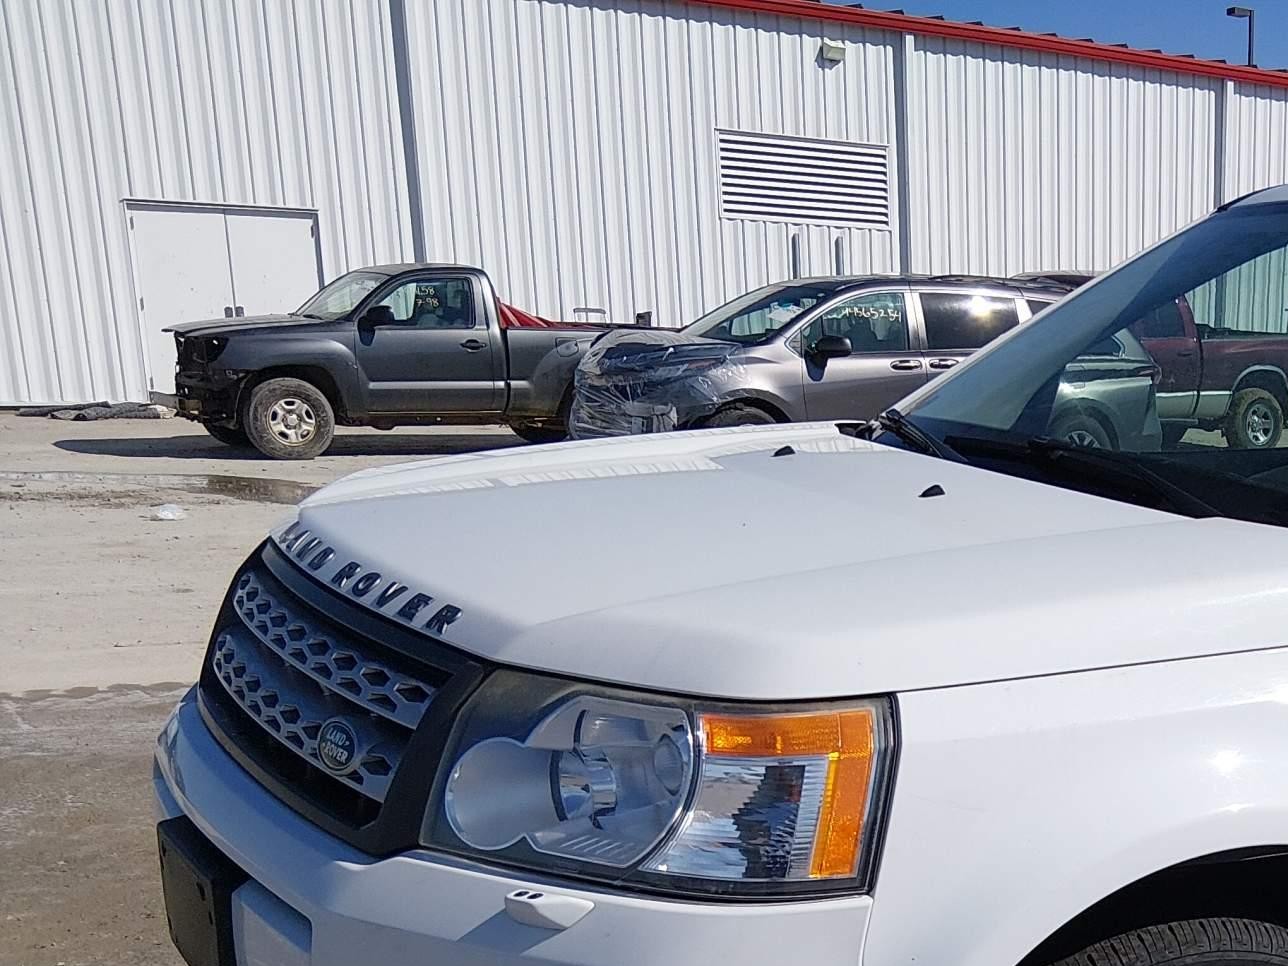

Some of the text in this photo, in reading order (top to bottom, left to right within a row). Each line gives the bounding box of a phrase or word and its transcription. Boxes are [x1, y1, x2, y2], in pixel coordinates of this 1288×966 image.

[331, 561, 464, 635] ROVER
[326, 727, 347, 746] LAND
[323, 741, 349, 764] ROVER
